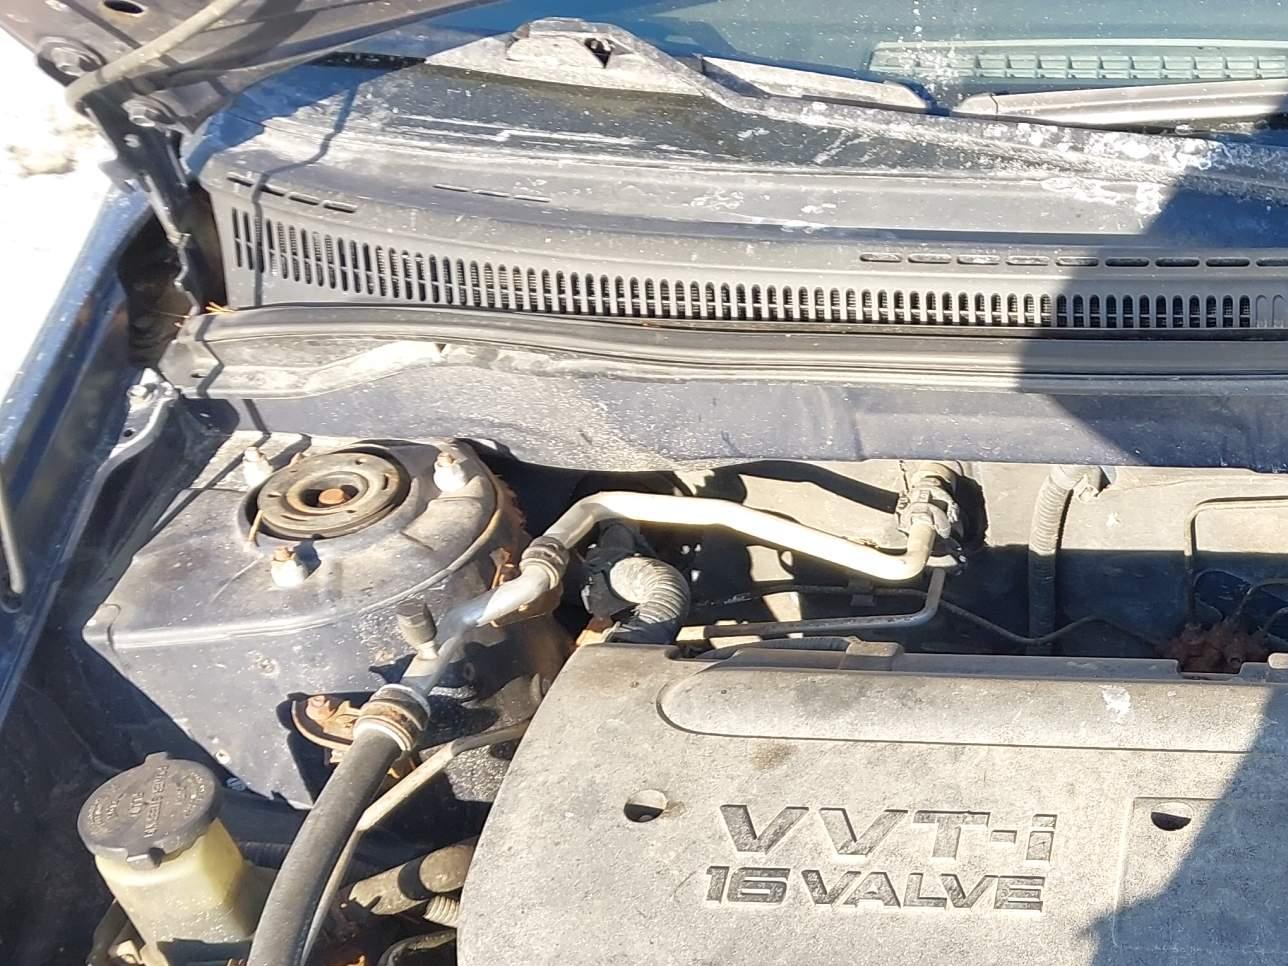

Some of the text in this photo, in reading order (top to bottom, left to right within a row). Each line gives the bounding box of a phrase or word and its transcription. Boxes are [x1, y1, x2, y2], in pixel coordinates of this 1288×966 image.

[719, 804, 1058, 862] VVT-i
[706, 866, 1046, 912] 16 VALVE
